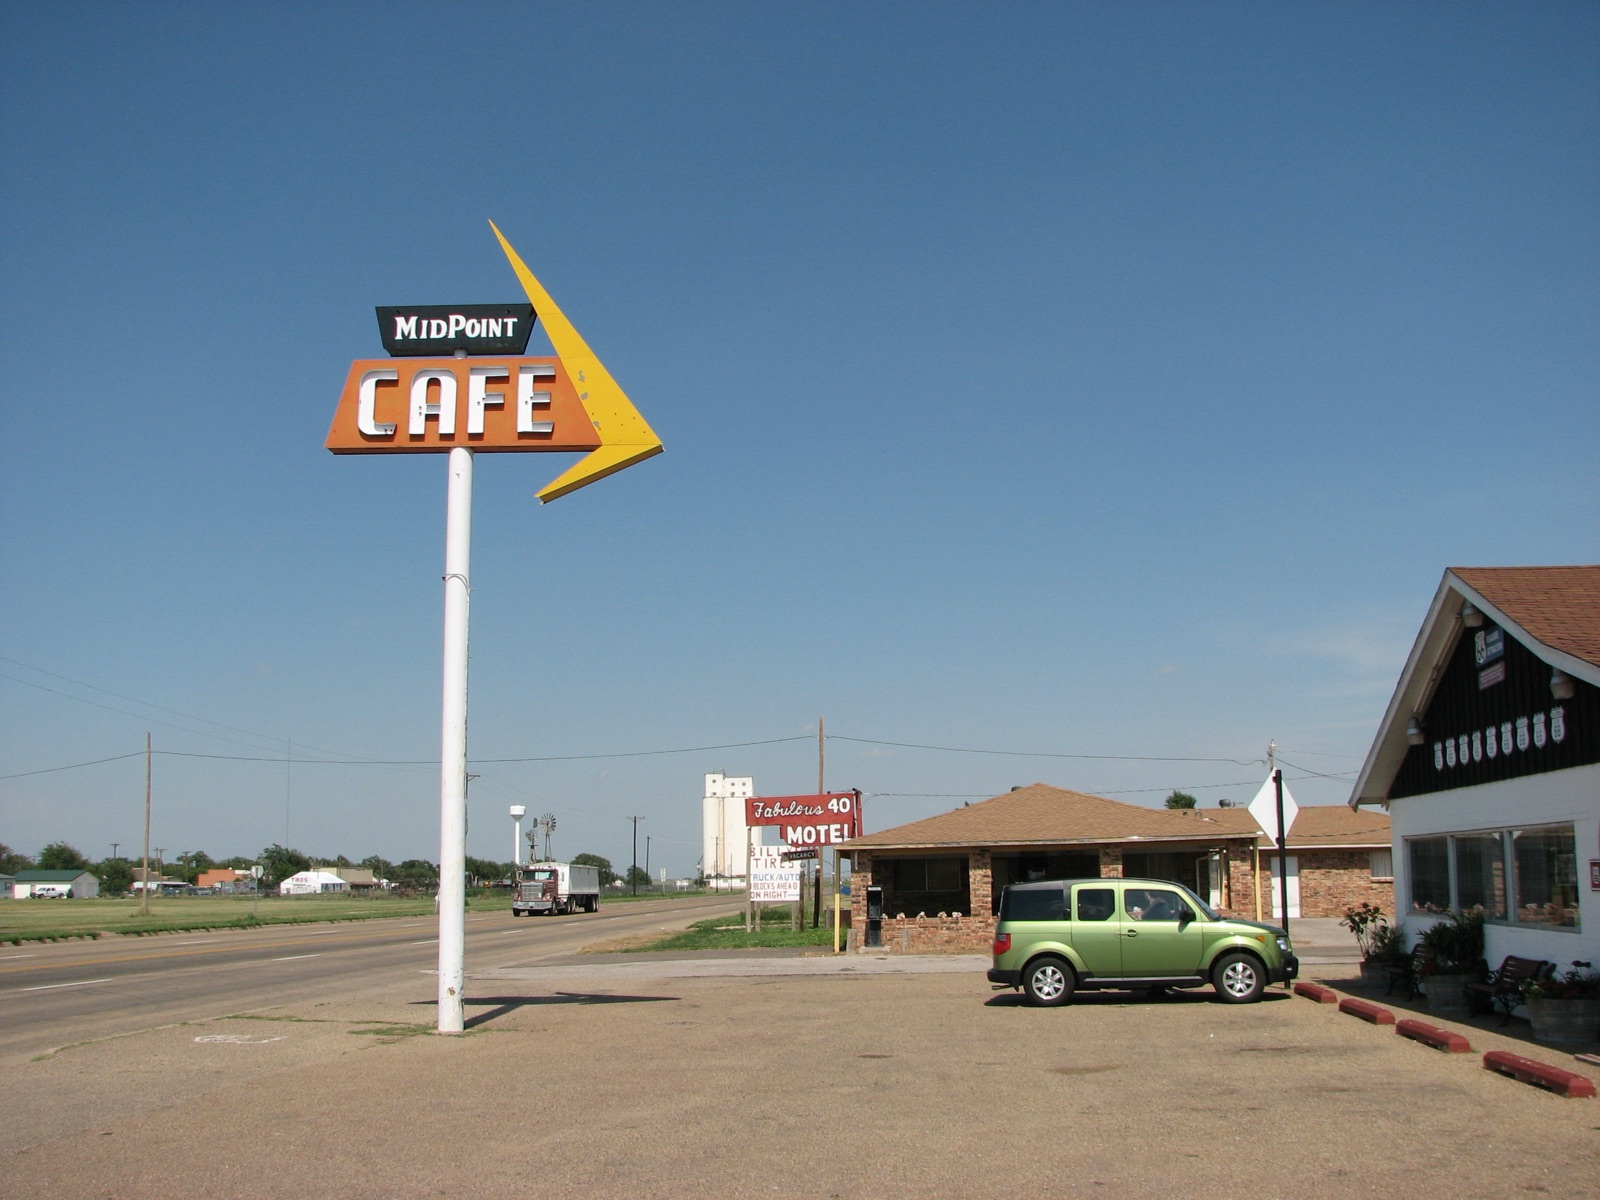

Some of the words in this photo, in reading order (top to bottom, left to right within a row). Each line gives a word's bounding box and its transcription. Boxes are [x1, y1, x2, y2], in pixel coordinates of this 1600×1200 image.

[357, 364, 556, 436] CAFE
[753, 801, 824, 818] Fabulous
[828, 797, 851, 813] 40
[787, 823, 851, 845] MOTEL
[789, 851, 815, 859] VACANCY
[753, 882, 775, 891] BLOCKS
[777, 882, 797, 890] AHEAD
[763, 891, 788, 899] RIGHT
